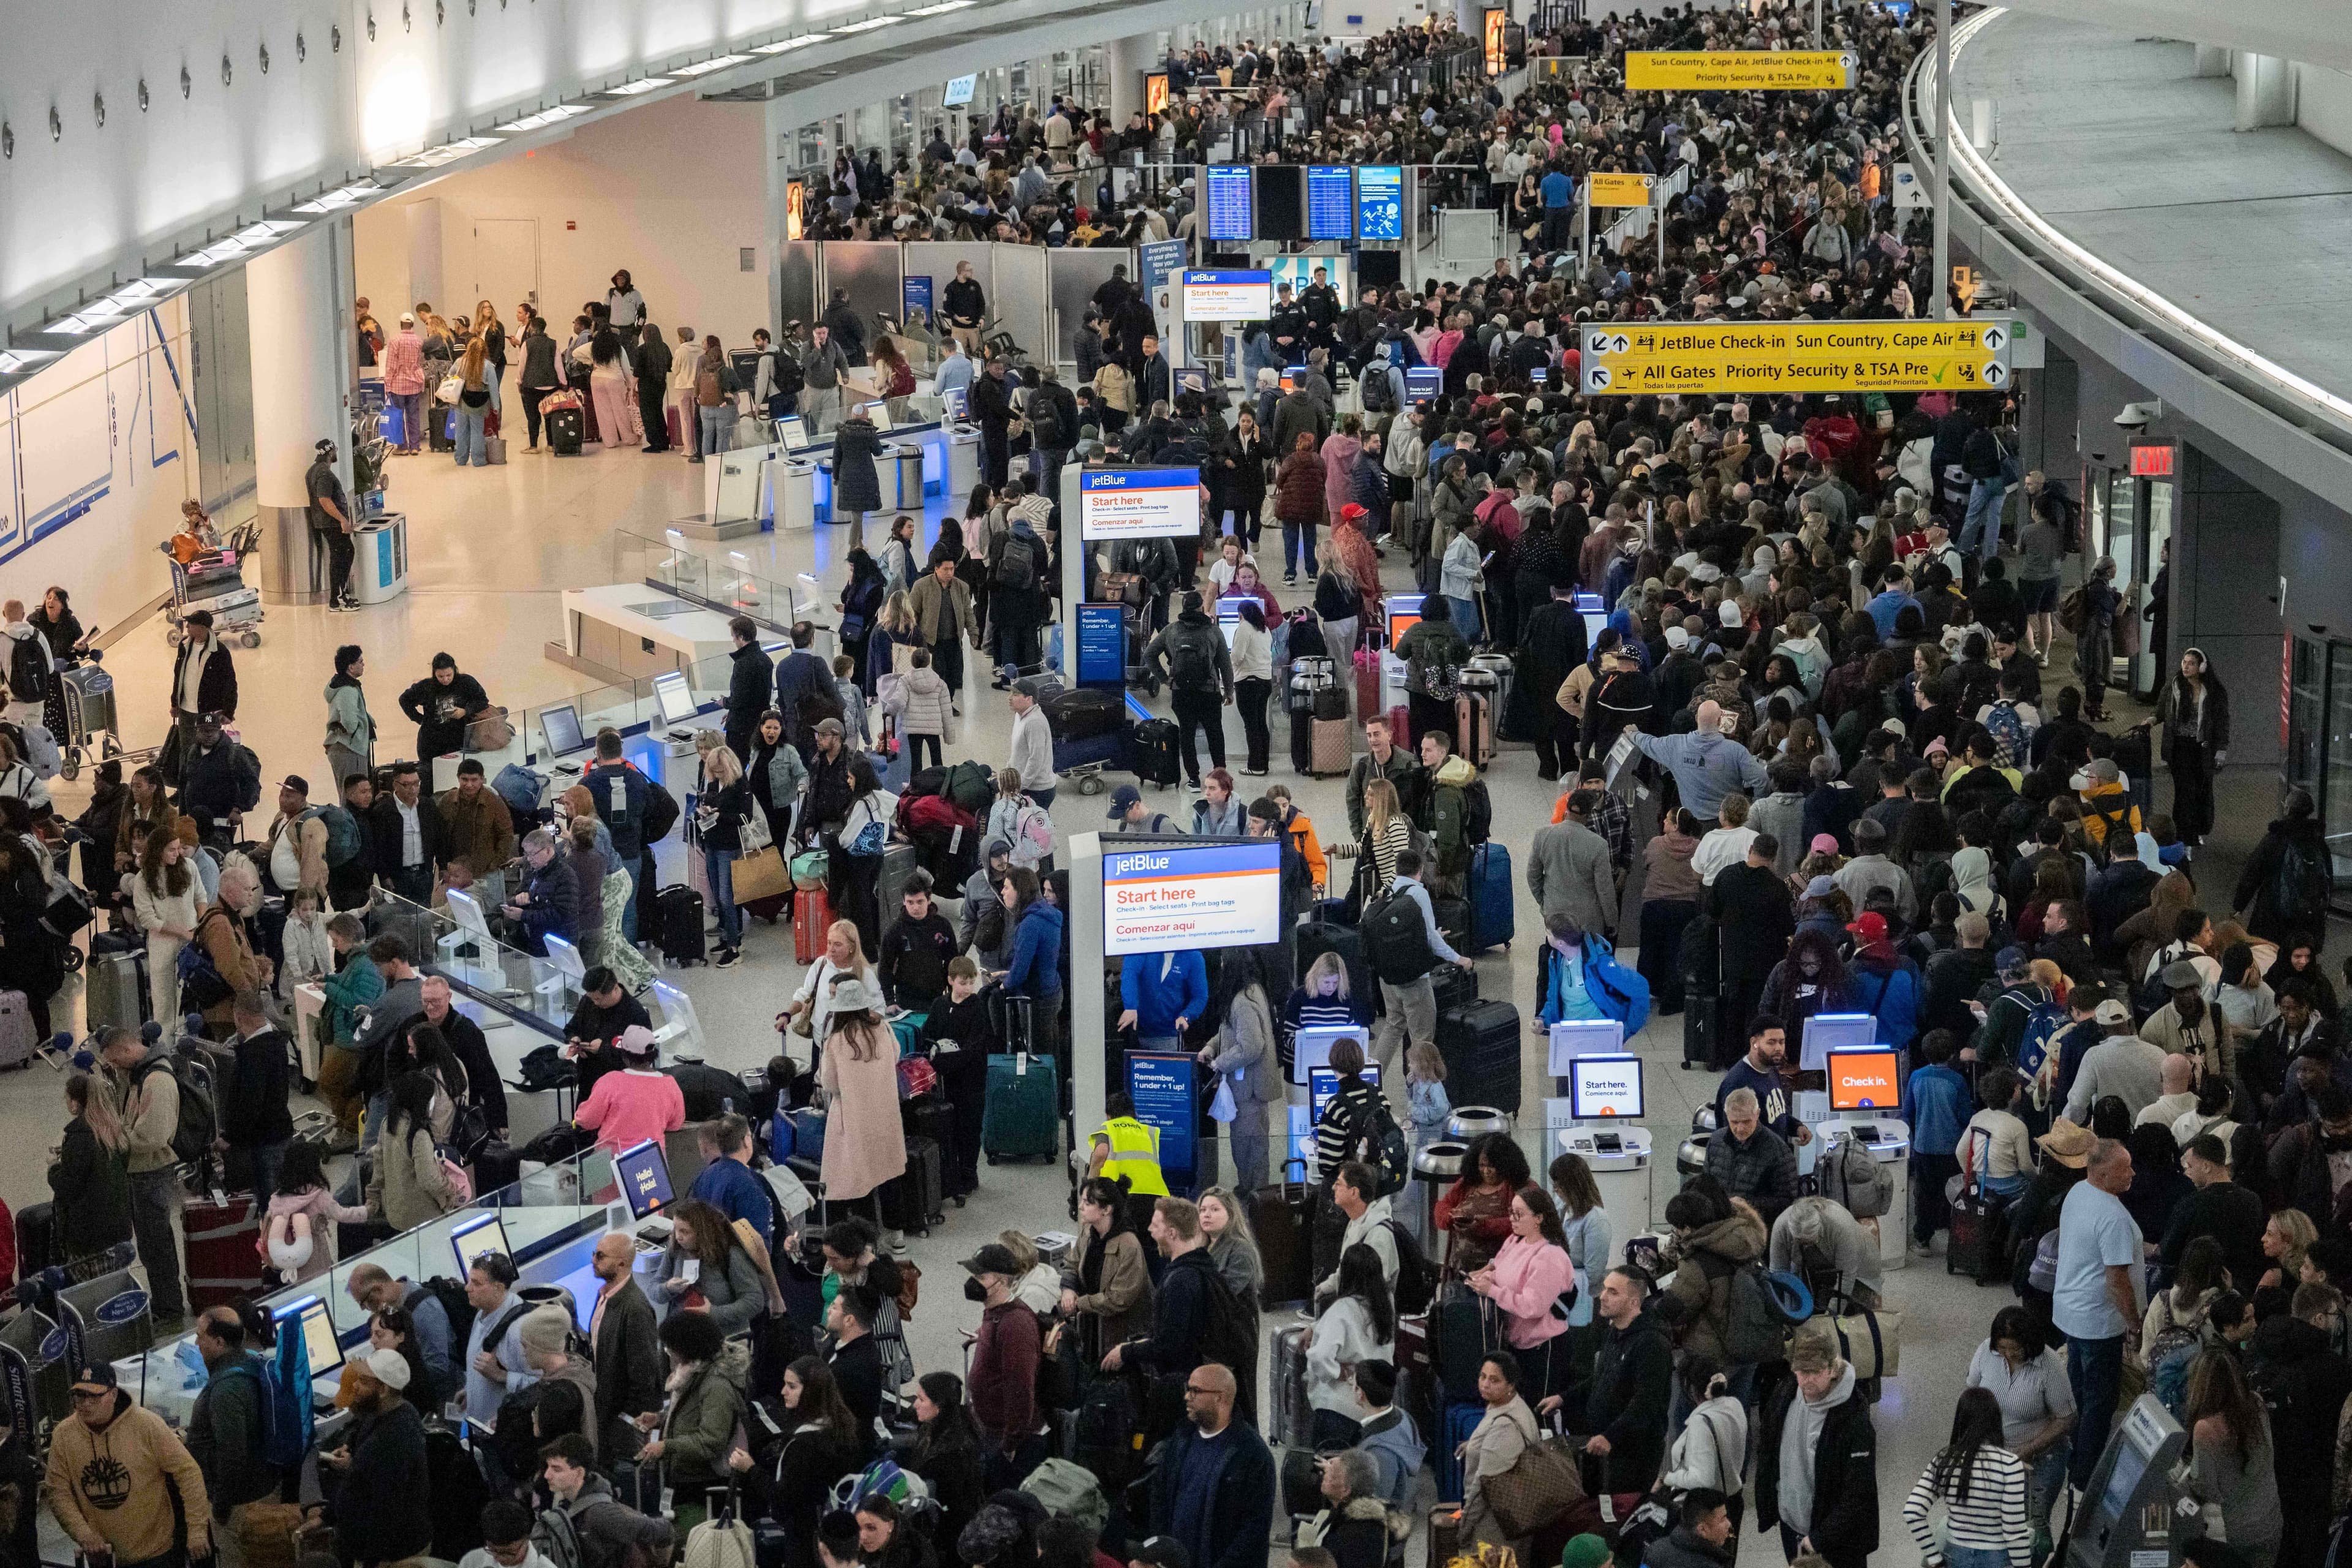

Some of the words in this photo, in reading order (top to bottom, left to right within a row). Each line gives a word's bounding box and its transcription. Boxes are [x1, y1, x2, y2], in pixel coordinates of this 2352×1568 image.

[1670, 58, 1708, 67] Country,
[1711, 58, 1728, 67] Cape
[1735, 58, 1749, 67] Air,
[1696, 74, 1727, 83] Priority
[1730, 74, 1765, 83] Security
[1190, 274, 1216, 283] jetBlue
[1660, 335, 1716, 350] JetBlue
[1721, 334, 1785, 349] Check-in
[1796, 334, 1822, 348] Sun
[1827, 334, 1888, 350] Country,
[1893, 333, 1928, 349] Cape
[1932, 333, 1953, 346] Air
[1643, 365, 1665, 379] All
[1671, 365, 1716, 379] Gates
[1727, 364, 1782, 381] Priority
[1787, 363, 1849, 380] Security
[1854, 363, 1865, 376] &
[1870, 362, 1900, 375] TSA
[1905, 362, 1929, 375] Pre
[1855, 379, 1891, 388] Seguridad
[2137, 447, 2169, 473] EXIT
[1091, 475, 1126, 488] jetBlue
[1092, 497, 1118, 507] Start
[1120, 496, 1144, 505] here
[1128, 518, 1144, 526] aquí
[1115, 854, 1169, 876] jetBlue
[1117, 889, 1157, 904] Start
[1161, 888, 1196, 901] here
[1116, 924, 1170, 935] Comenzar
[1172, 919, 1196, 932] aquí
[1134, 1073, 1175, 1083] Remember,
[1842, 1077, 1874, 1088] Check
[1875, 1076, 1888, 1086] in.
[1173, 1083, 1185, 1092] up!
[636, 1167, 654, 1183] Hello!
[639, 1178, 657, 1196] ¡Hola!
[111, 1308, 124, 1316] New
[124, 1302, 137, 1313] York
